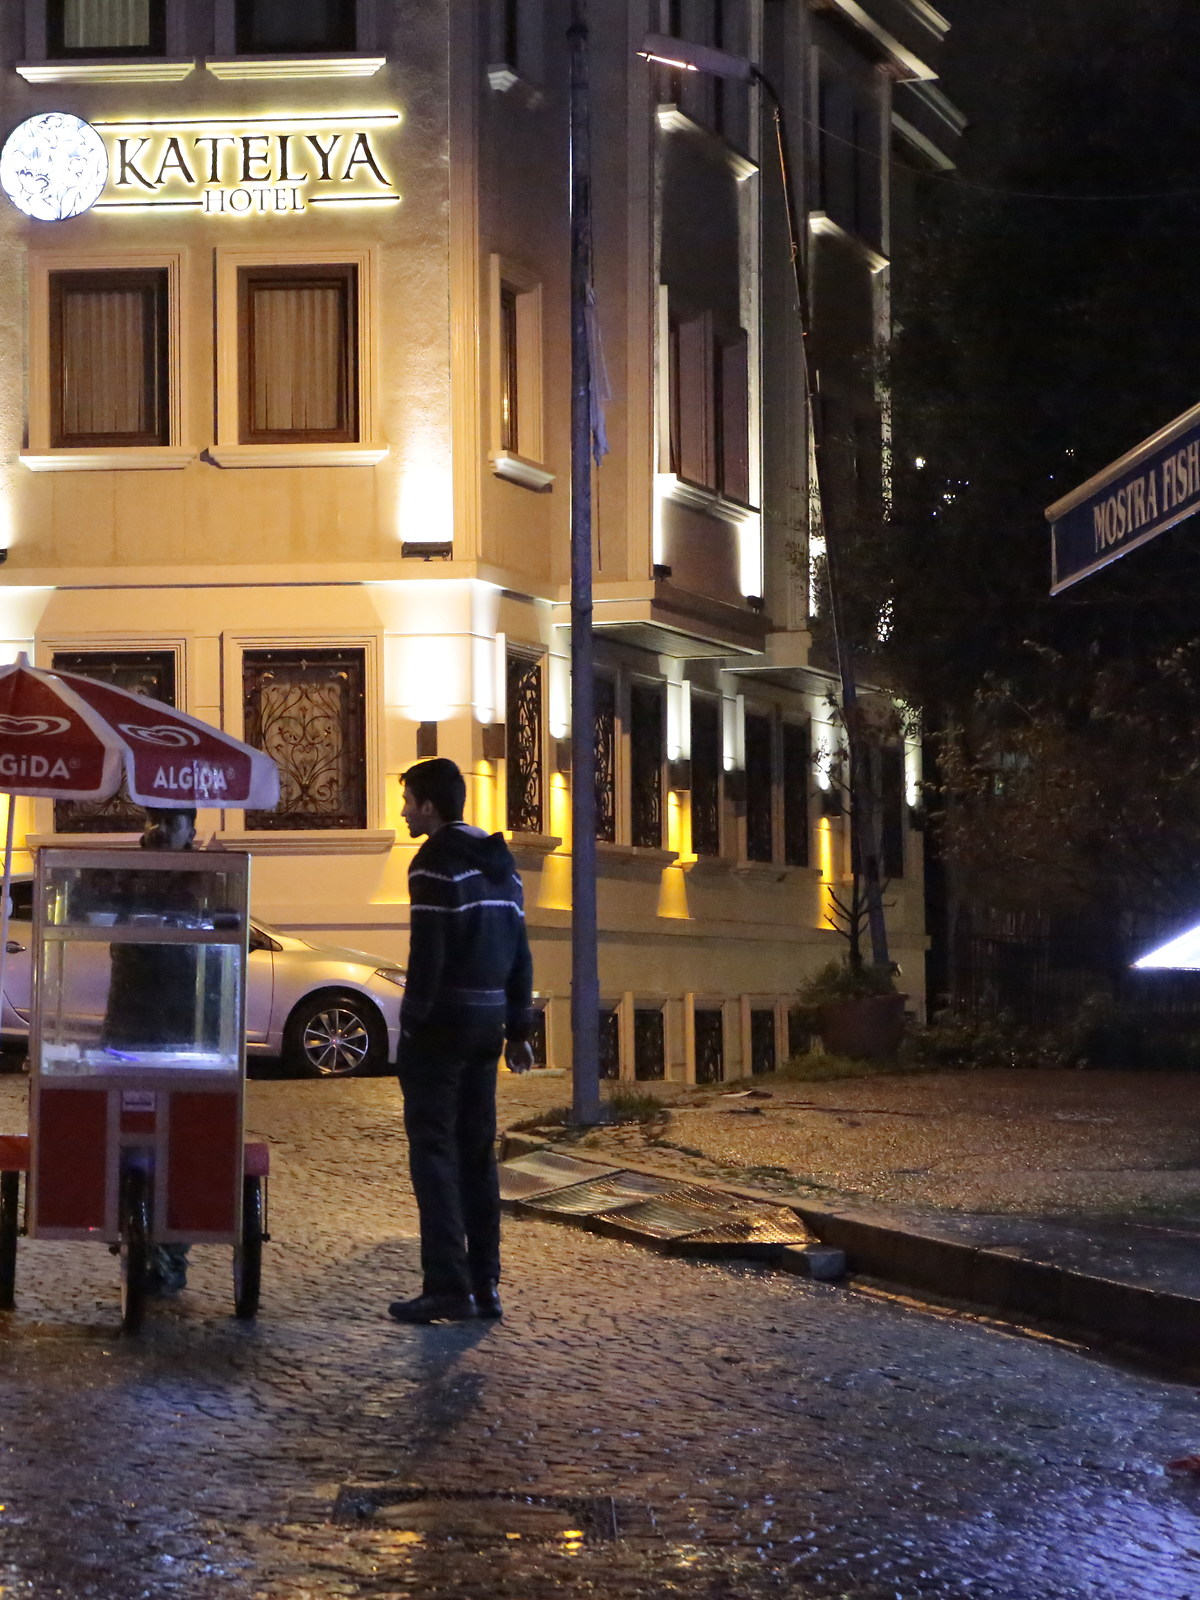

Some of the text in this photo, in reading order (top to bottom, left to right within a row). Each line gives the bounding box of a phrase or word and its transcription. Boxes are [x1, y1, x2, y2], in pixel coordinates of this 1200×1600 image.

[116, 132, 392, 190] KATELYA
[204, 188, 306, 214] HOTEL
[1093, 439, 1200, 553] MOSTRA FISH
